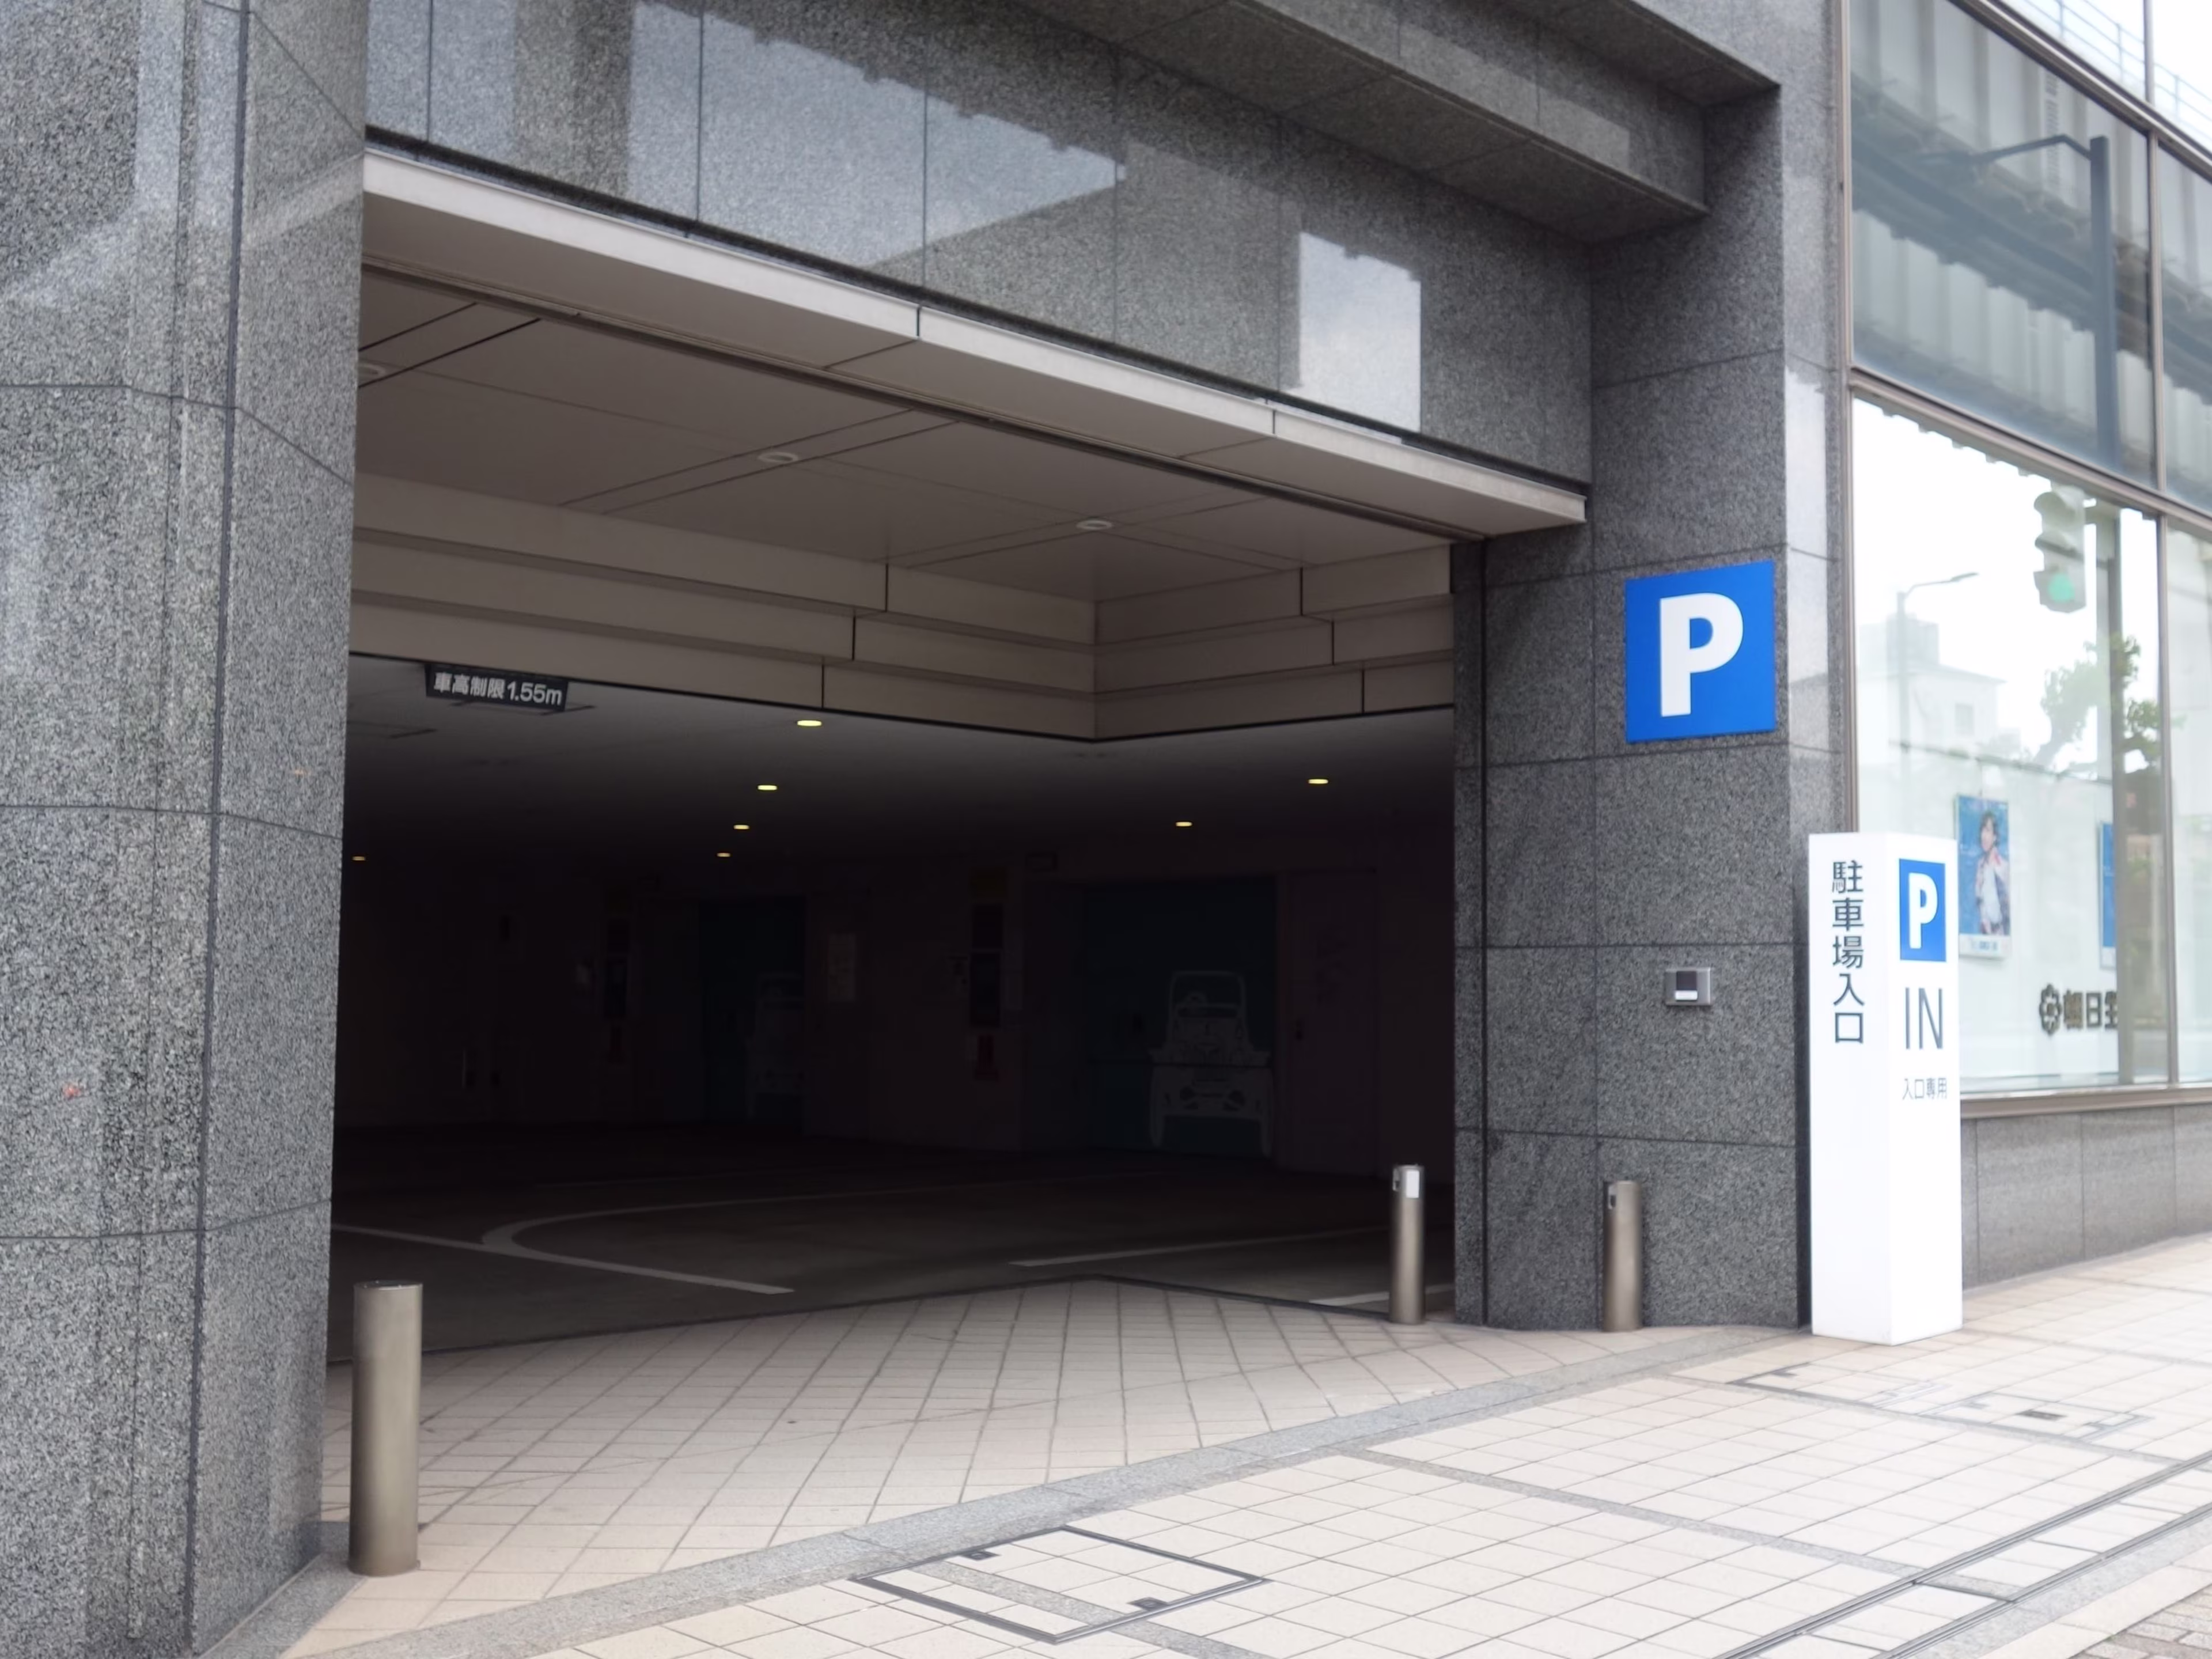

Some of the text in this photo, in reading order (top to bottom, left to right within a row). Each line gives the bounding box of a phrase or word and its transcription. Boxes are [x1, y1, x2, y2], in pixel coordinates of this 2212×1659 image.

[1660, 593, 1744, 717] P
[1908, 872, 1938, 949] P
[1832, 860, 1865, 1044] 駐車場入口
[1905, 987, 1944, 1050] IN
[1902, 1077, 1948, 1100] 入口専用
